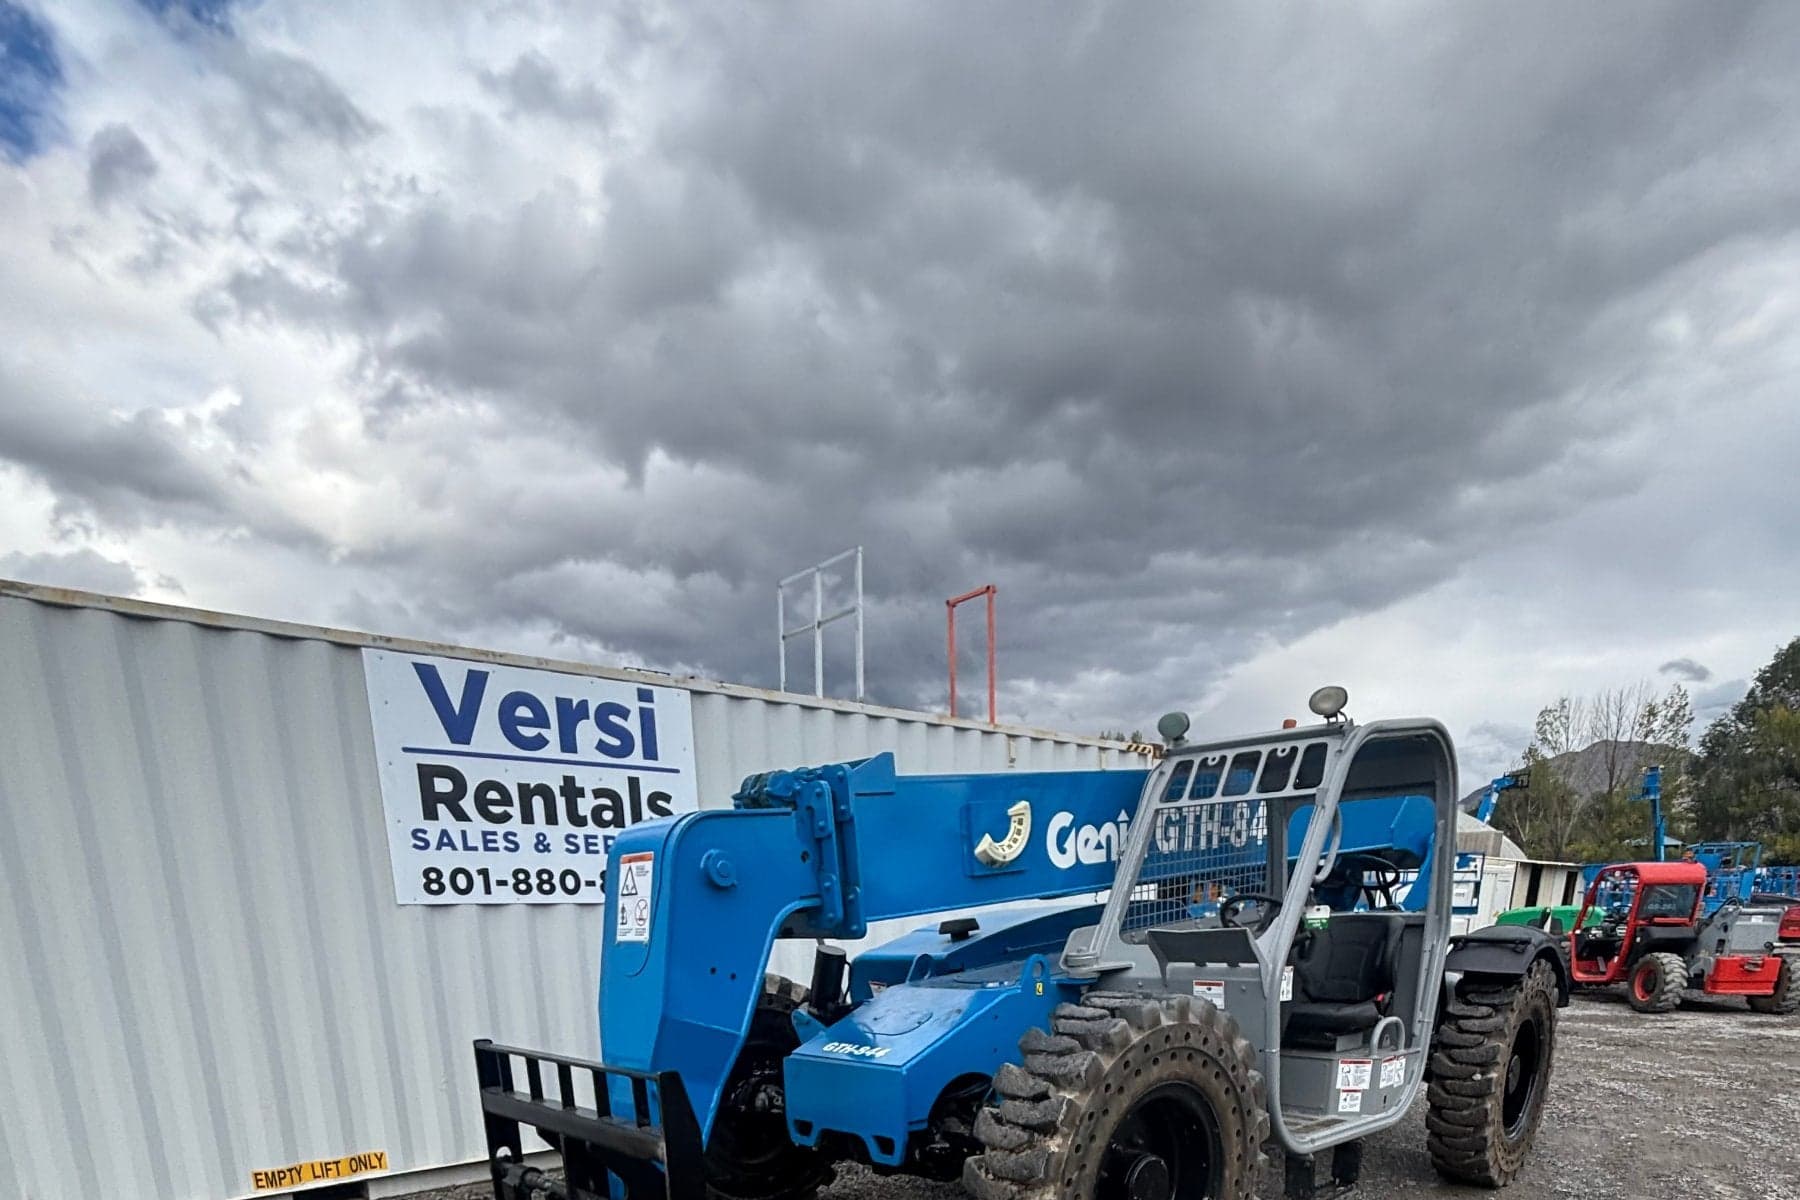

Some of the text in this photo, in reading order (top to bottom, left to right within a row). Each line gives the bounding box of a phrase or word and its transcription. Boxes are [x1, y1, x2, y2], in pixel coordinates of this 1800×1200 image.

[411, 661, 659, 762] Versi
[416, 762, 674, 829] Rentals
[411, 828, 521, 853] SALES
[534, 832, 553, 854] &
[1046, 808, 1131, 869] Geni
[253, 1151, 385, 1189] EMPTY LIFT ONLY
